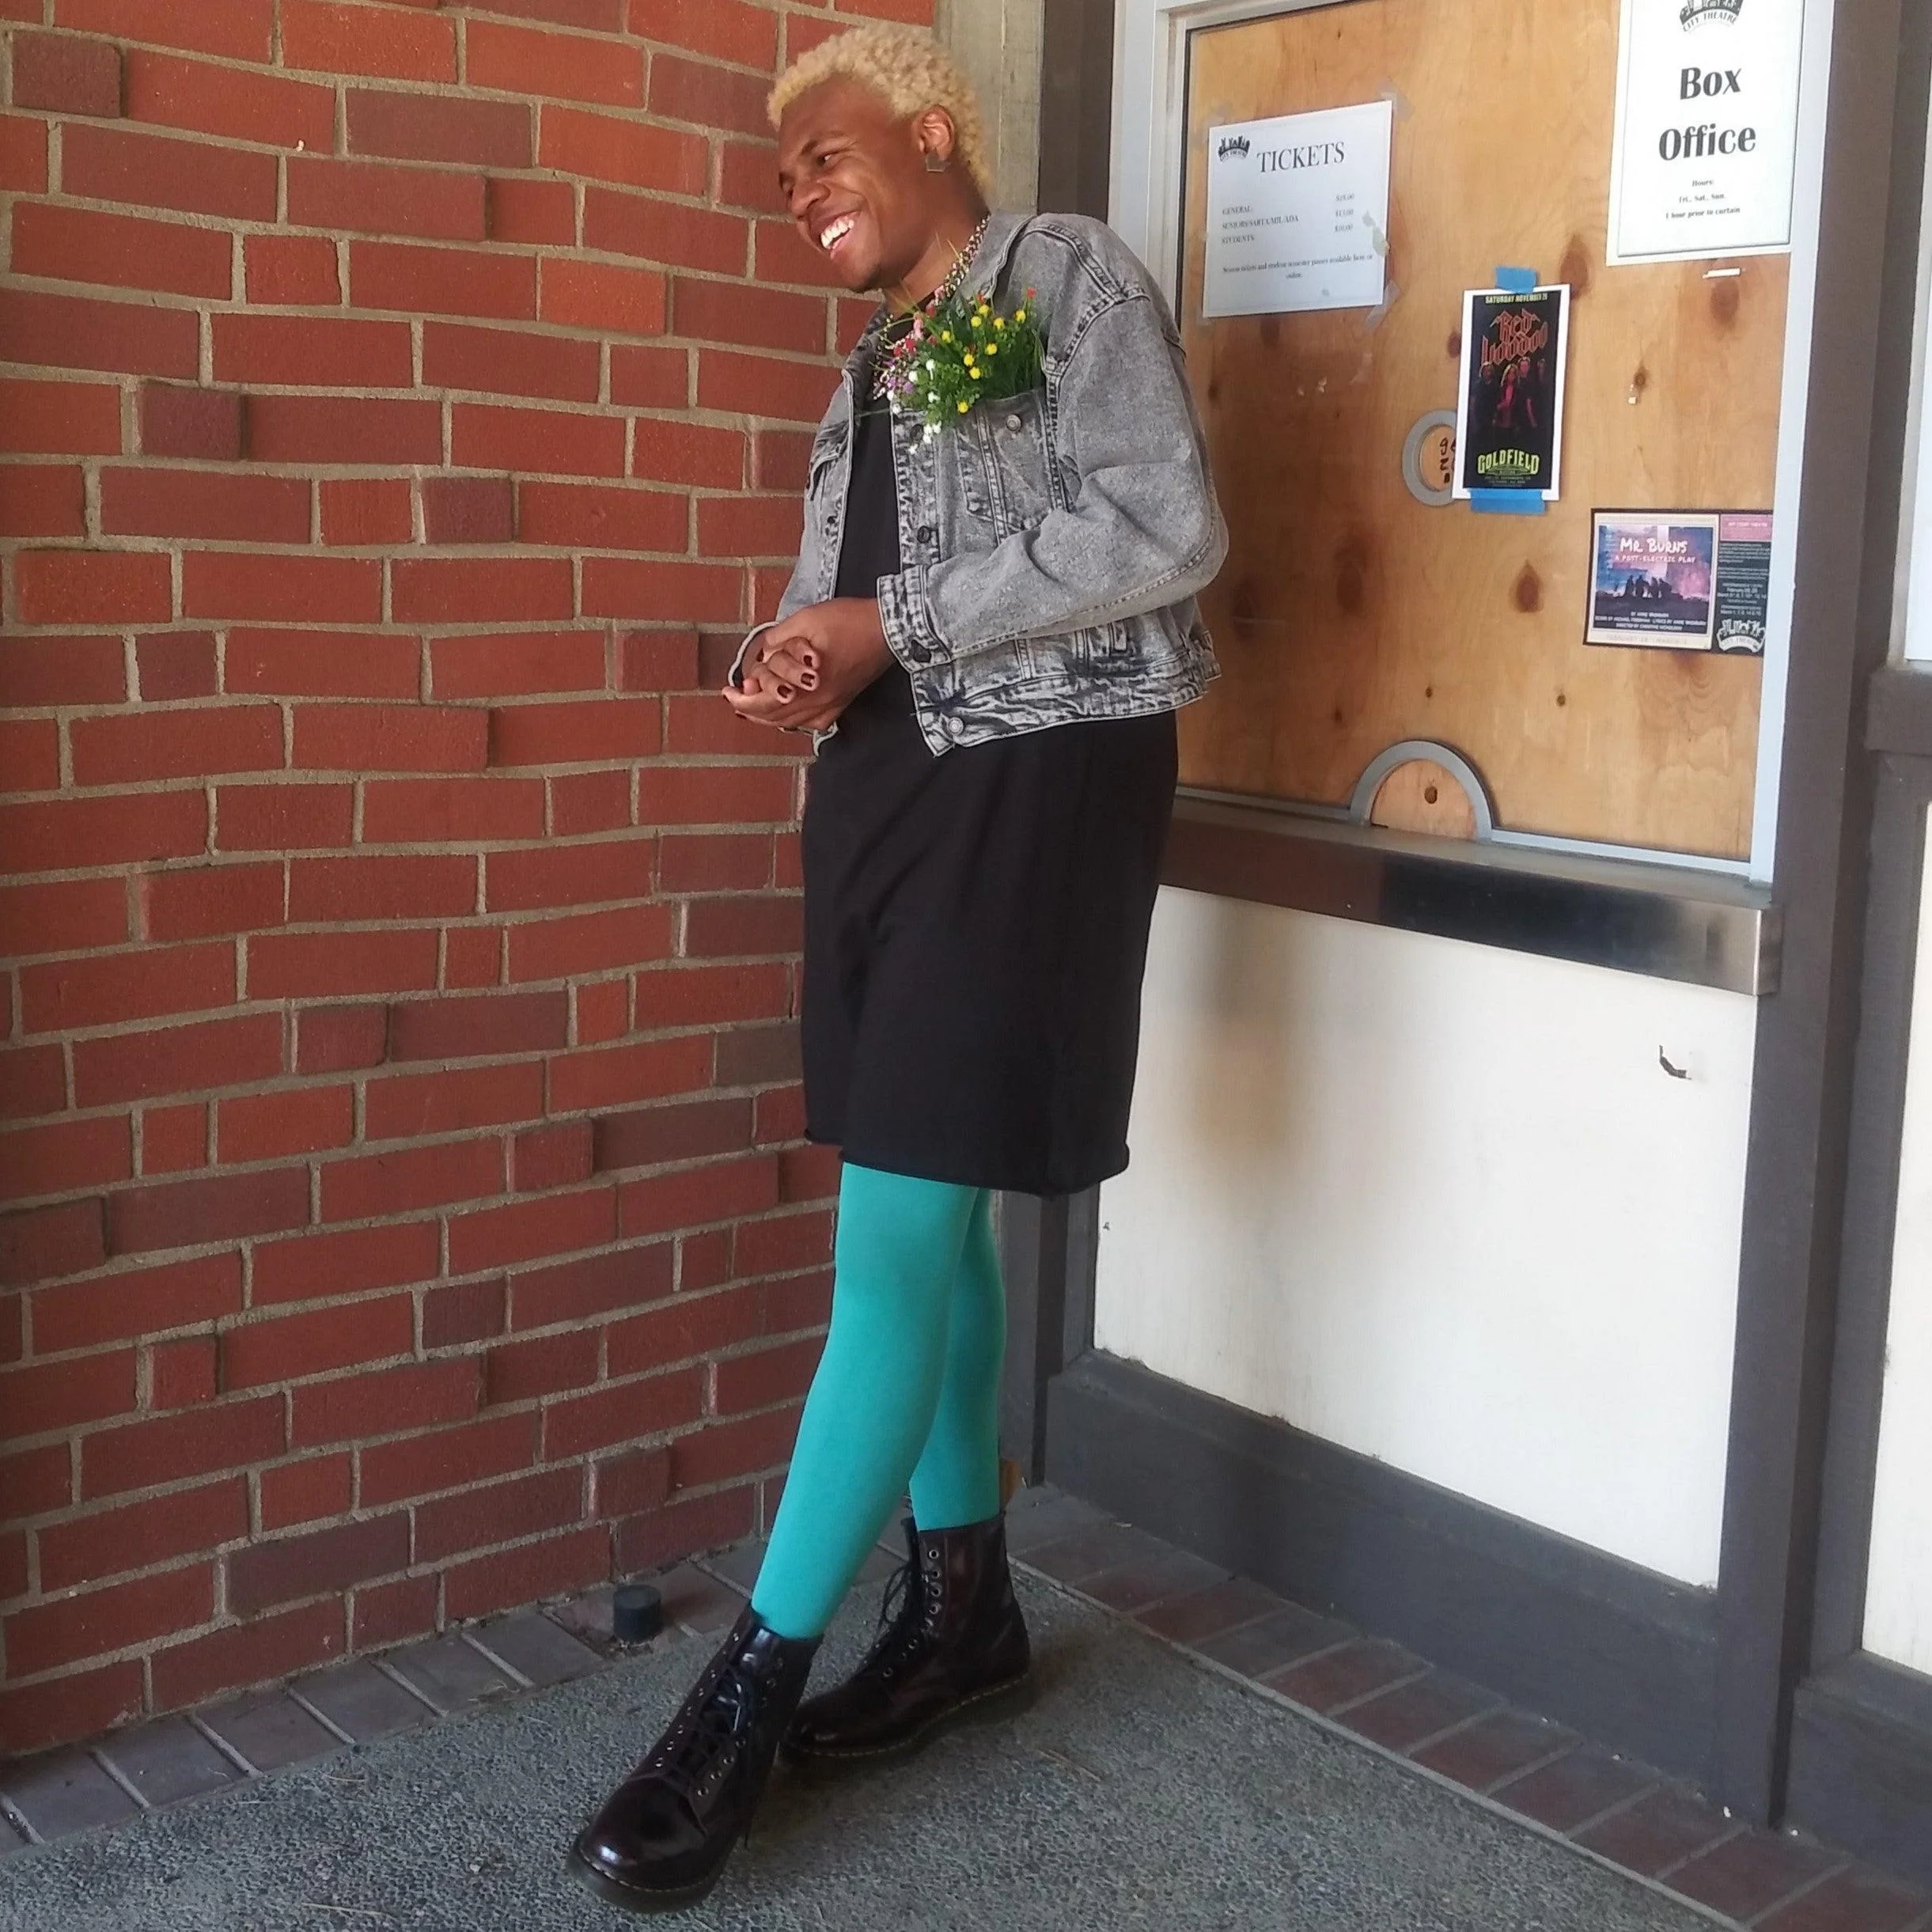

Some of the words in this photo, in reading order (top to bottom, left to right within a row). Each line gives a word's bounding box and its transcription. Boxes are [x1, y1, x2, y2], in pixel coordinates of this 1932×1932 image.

[1682, 17, 1699, 32] CITY
[1680, 67, 1741, 100] Box
[1659, 123, 1756, 161] Office
[1256, 141, 1345, 173] TICKETS
[1688, 210, 1704, 219] prior
[1485, 295, 1514, 304] SATURDAY
[1515, 294, 1542, 302] NOVEMBER
[1477, 449, 1540, 475] GOLDFIELD
[1646, 538, 1688, 554] BURNS
